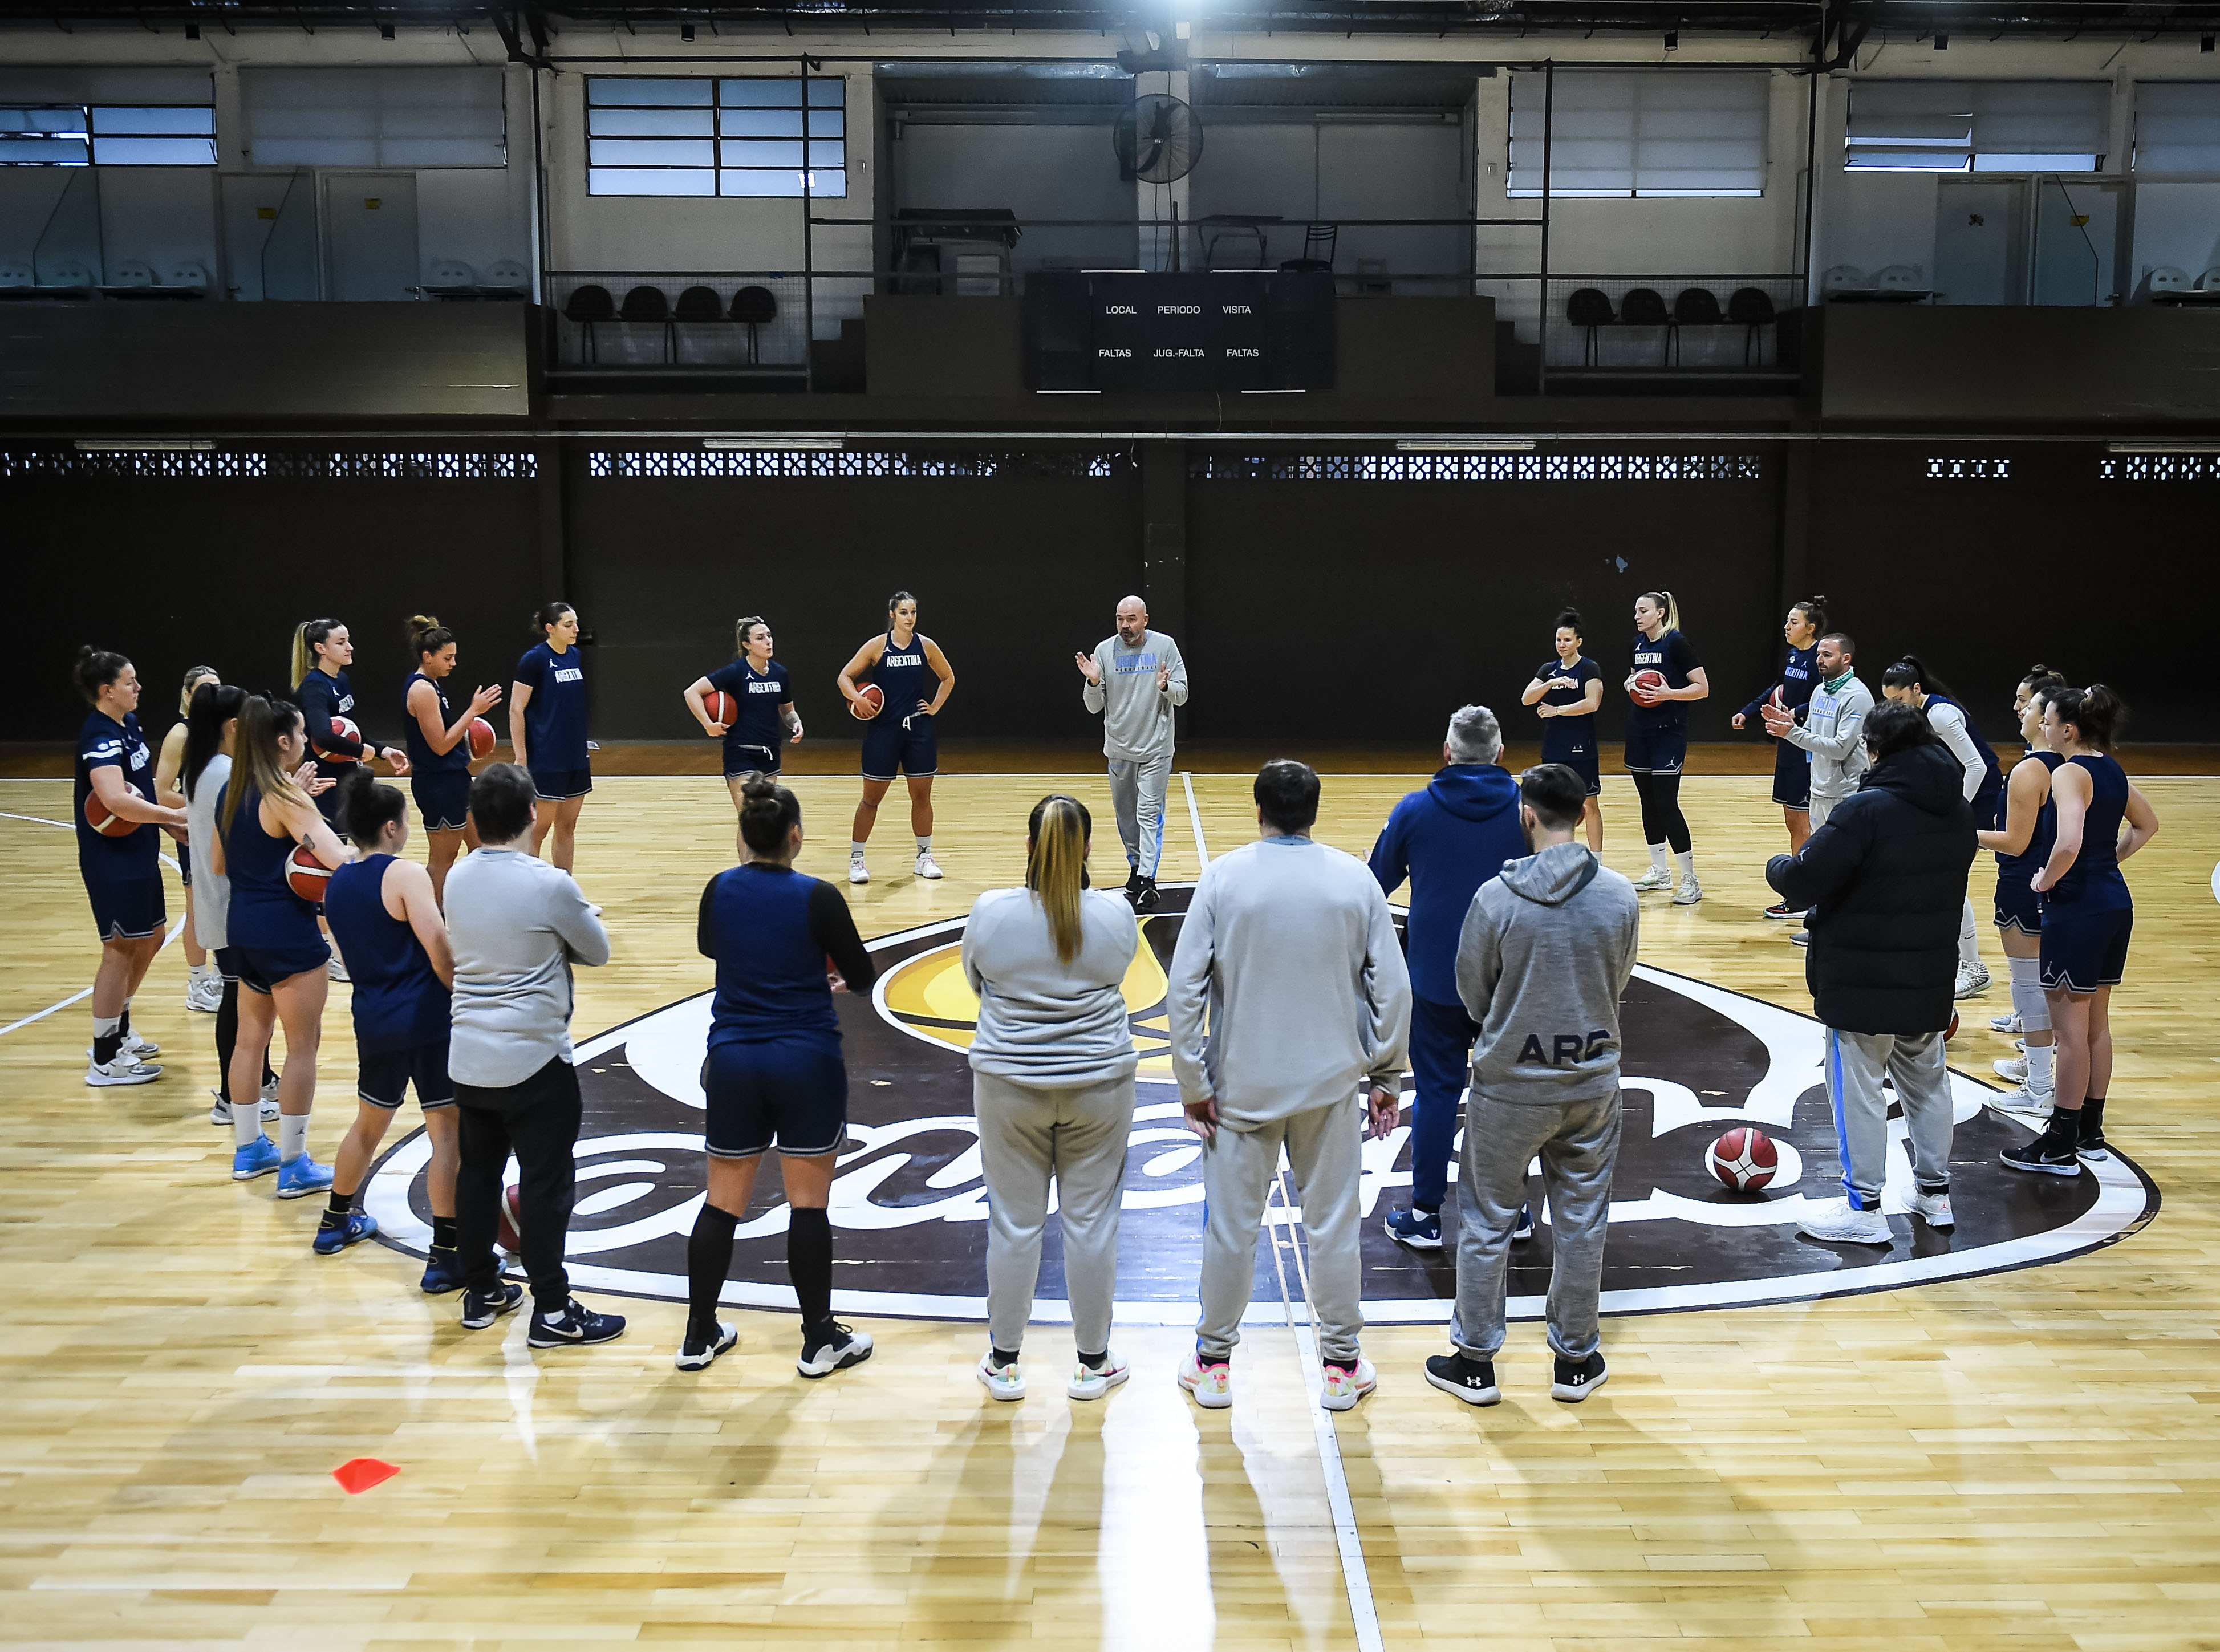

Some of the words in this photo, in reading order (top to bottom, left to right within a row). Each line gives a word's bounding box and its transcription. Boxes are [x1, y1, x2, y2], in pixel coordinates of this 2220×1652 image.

[1106, 305, 1137, 314] LOCAL
[1157, 305, 1201, 314] PERIODO
[1222, 305, 1251, 314] VISITA
[1099, 348, 1131, 358] FALTAS
[1153, 348, 1205, 358] JUG.-FALTA
[1227, 348, 1259, 358] FALTAS
[886, 654, 922, 668] ARGENTINA
